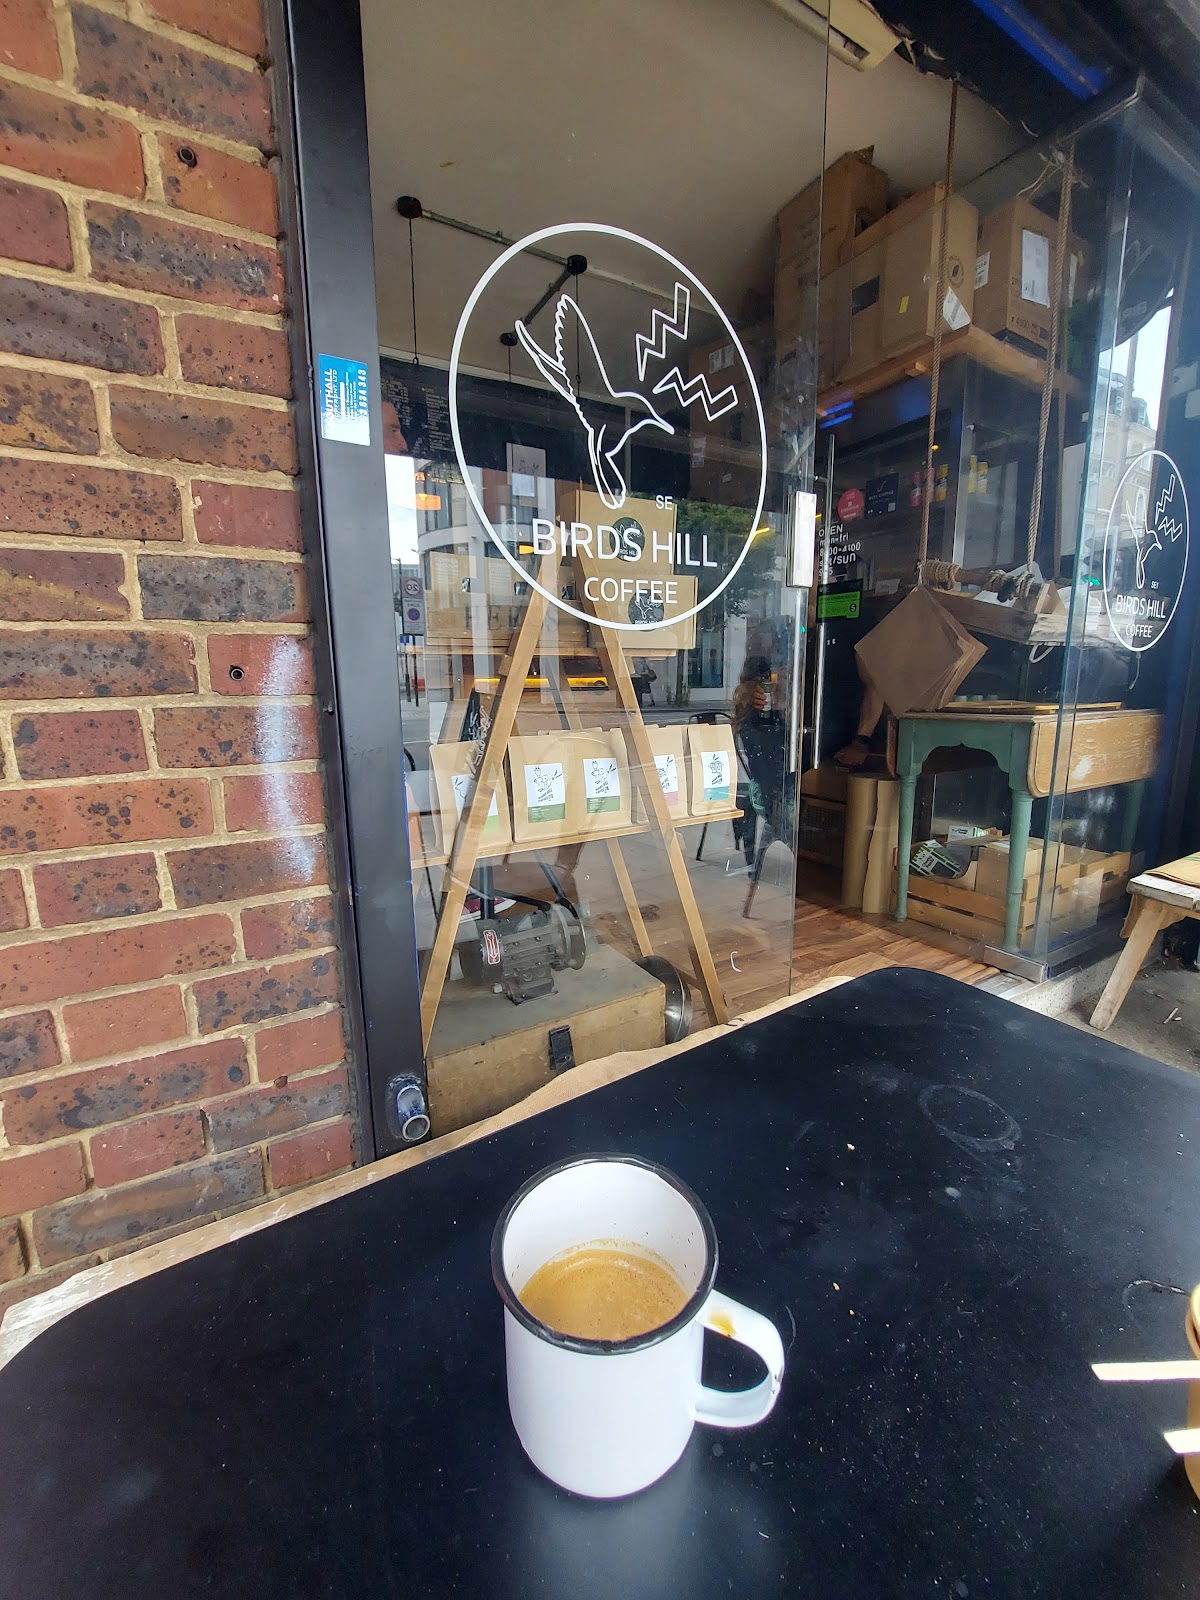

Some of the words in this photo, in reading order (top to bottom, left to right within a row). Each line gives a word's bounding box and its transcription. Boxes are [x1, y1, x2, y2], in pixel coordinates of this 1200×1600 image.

[358, 369, 367, 387] 343
[324, 368, 334, 425] OUTHALL
[819, 524, 843, 537] OEN
[819, 532, 848, 547] mn-fri
[532, 518, 641, 562] BIRDS
[652, 530, 718, 567] HILL
[584, 576, 678, 604] COFFEE
[1115, 594, 1145, 616] BIRDS
[1147, 598, 1166, 619] HILL
[1125, 623, 1153, 639] COFFEE
